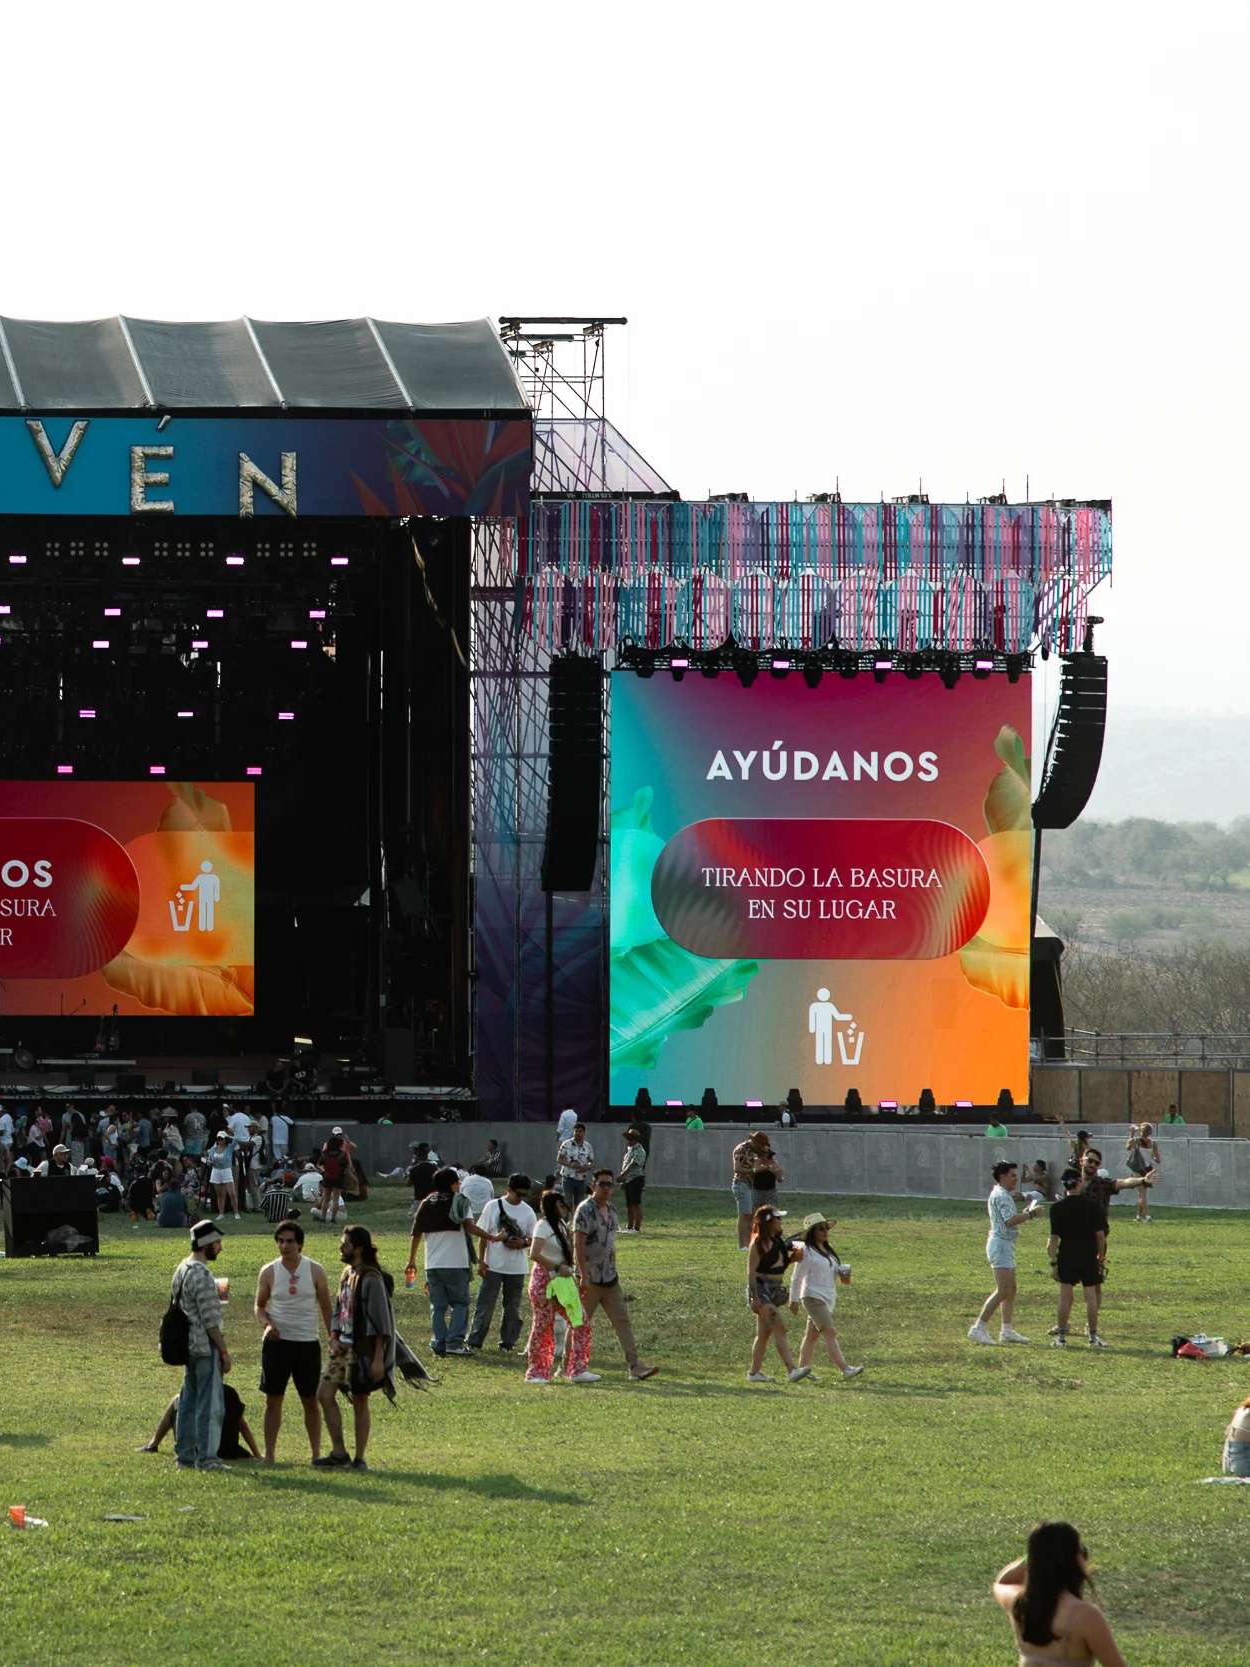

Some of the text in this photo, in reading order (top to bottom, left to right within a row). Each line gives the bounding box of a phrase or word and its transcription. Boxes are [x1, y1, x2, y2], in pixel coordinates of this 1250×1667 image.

[706, 741, 939, 782] AYÚDANOS
[702, 867, 943, 889] TIRANDO LA BASURA
[748, 900, 896, 920] EN SU LUGAR
